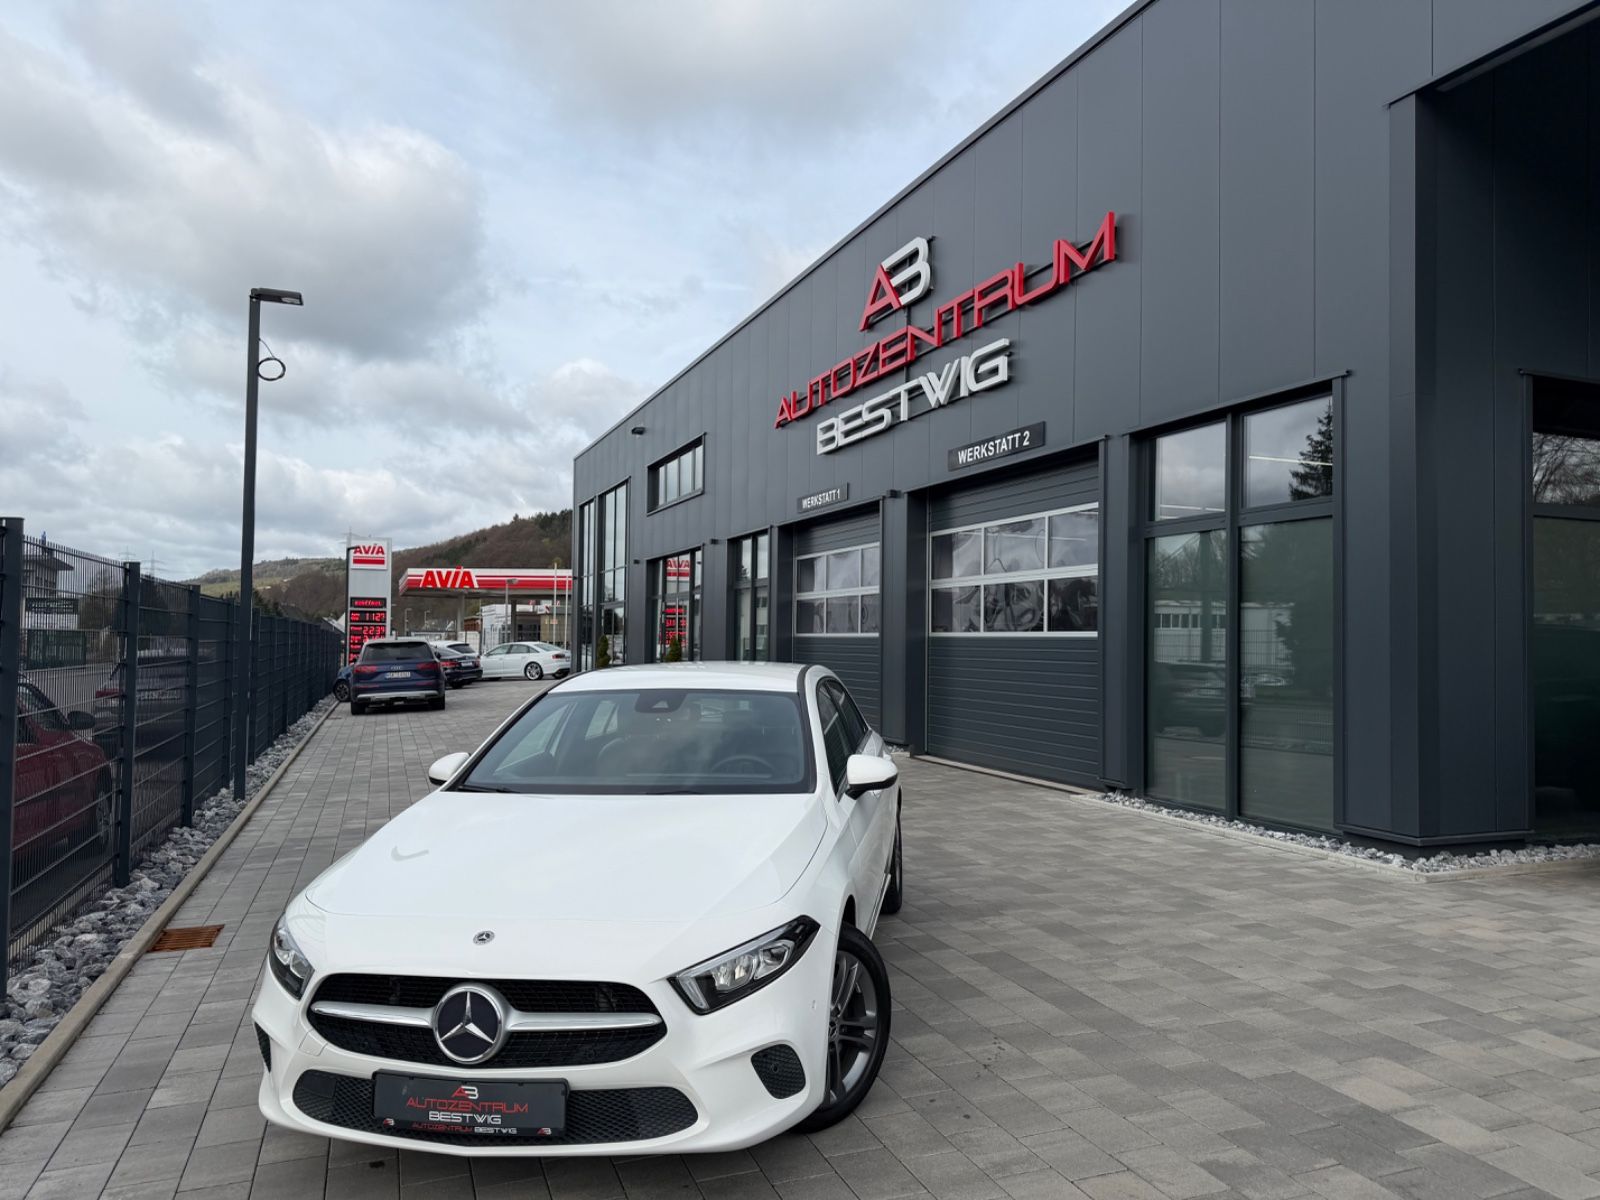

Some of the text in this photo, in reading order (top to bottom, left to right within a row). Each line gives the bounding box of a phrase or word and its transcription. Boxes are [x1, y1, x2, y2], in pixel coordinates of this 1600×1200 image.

[775, 211, 1116, 429] AUTOZENTRUM
[816, 338, 1010, 455] BESTWIG
[957, 430, 1031, 464] WERKSTATT 2
[801, 491, 836, 509] WERKSTATT
[353, 543, 385, 555] AVIA
[420, 565, 479, 589] AVIA
[406, 1097, 529, 1114] AUTOZENTRUM
[428, 1111, 502, 1125] BESTWIG
[474, 1126, 518, 1135] BESTWIG
